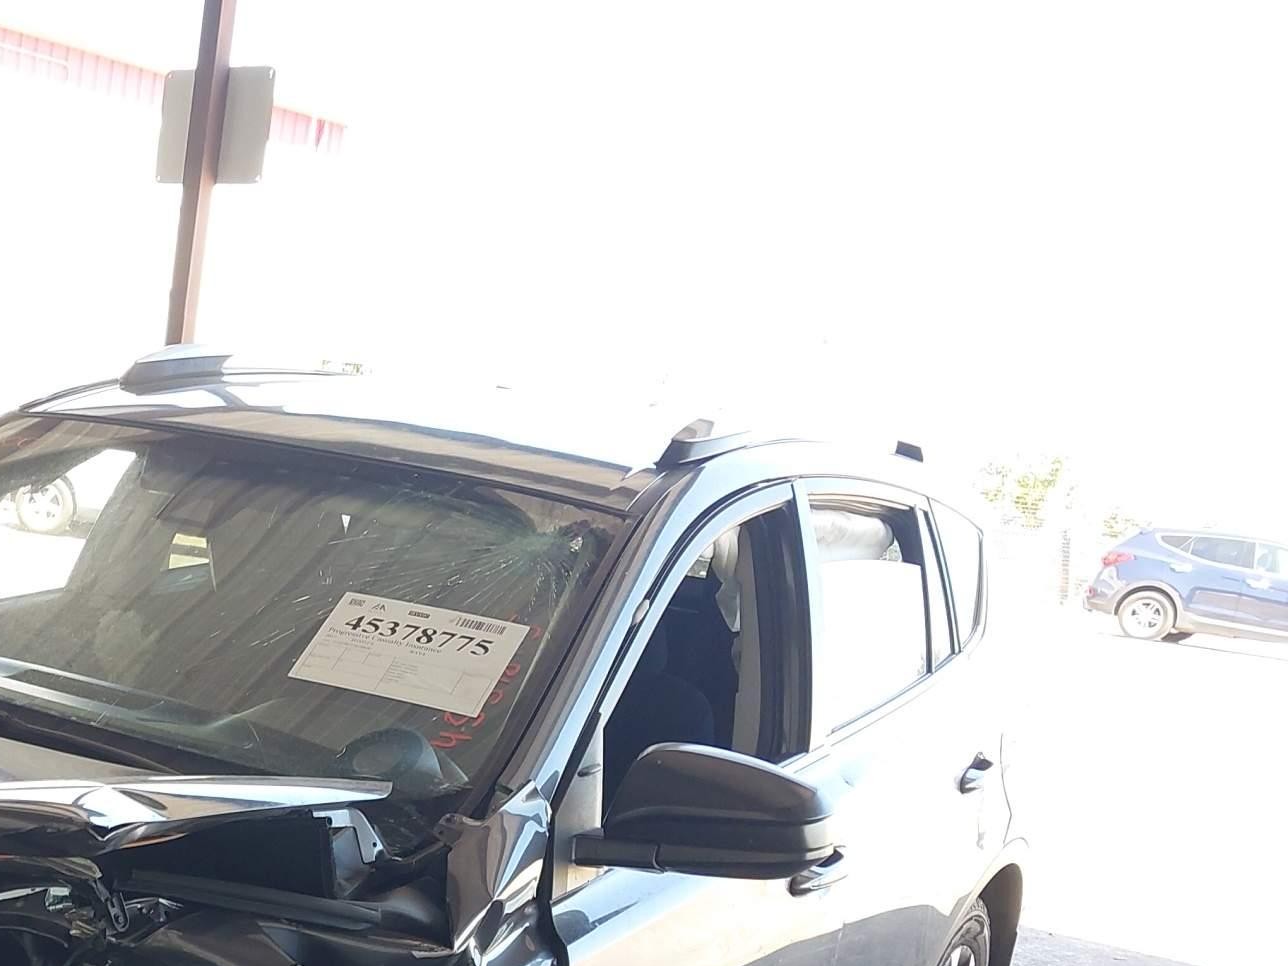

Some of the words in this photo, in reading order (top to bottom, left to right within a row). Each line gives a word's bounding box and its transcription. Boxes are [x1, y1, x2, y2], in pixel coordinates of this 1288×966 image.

[328, 627, 371, 640] Progressive
[372, 635, 403, 648] Casualty
[405, 643, 442, 654] Insurance
[345, 615, 494, 656] 45378775
